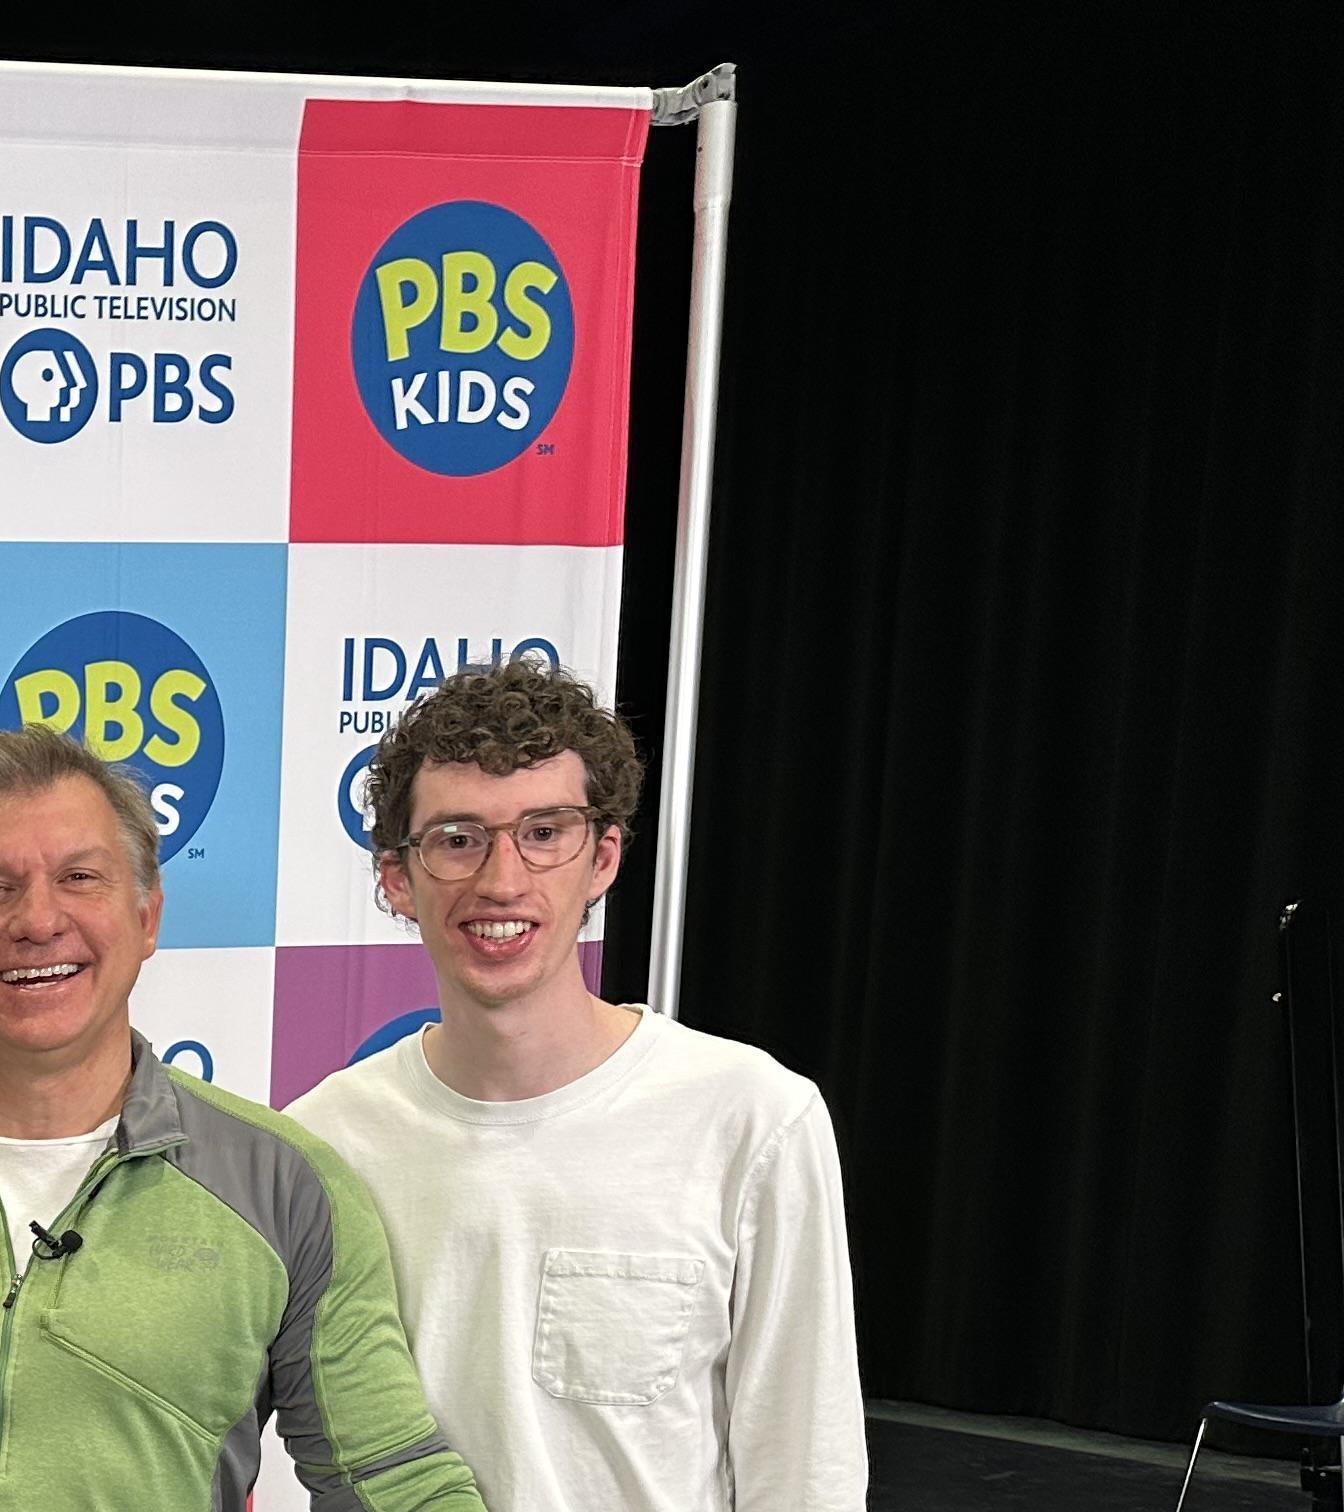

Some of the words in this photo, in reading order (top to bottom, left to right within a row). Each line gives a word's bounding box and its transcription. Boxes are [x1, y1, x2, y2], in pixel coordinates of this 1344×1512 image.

[0, 215, 238, 290] IDAHO
[93, 296, 237, 323] TELEVISION
[375, 250, 558, 362] PBS
[109, 353, 235, 425] PBS
[391, 371, 535, 431] KIDS
[14, 660, 207, 767] PBS
[188, 848, 204, 859] SM
